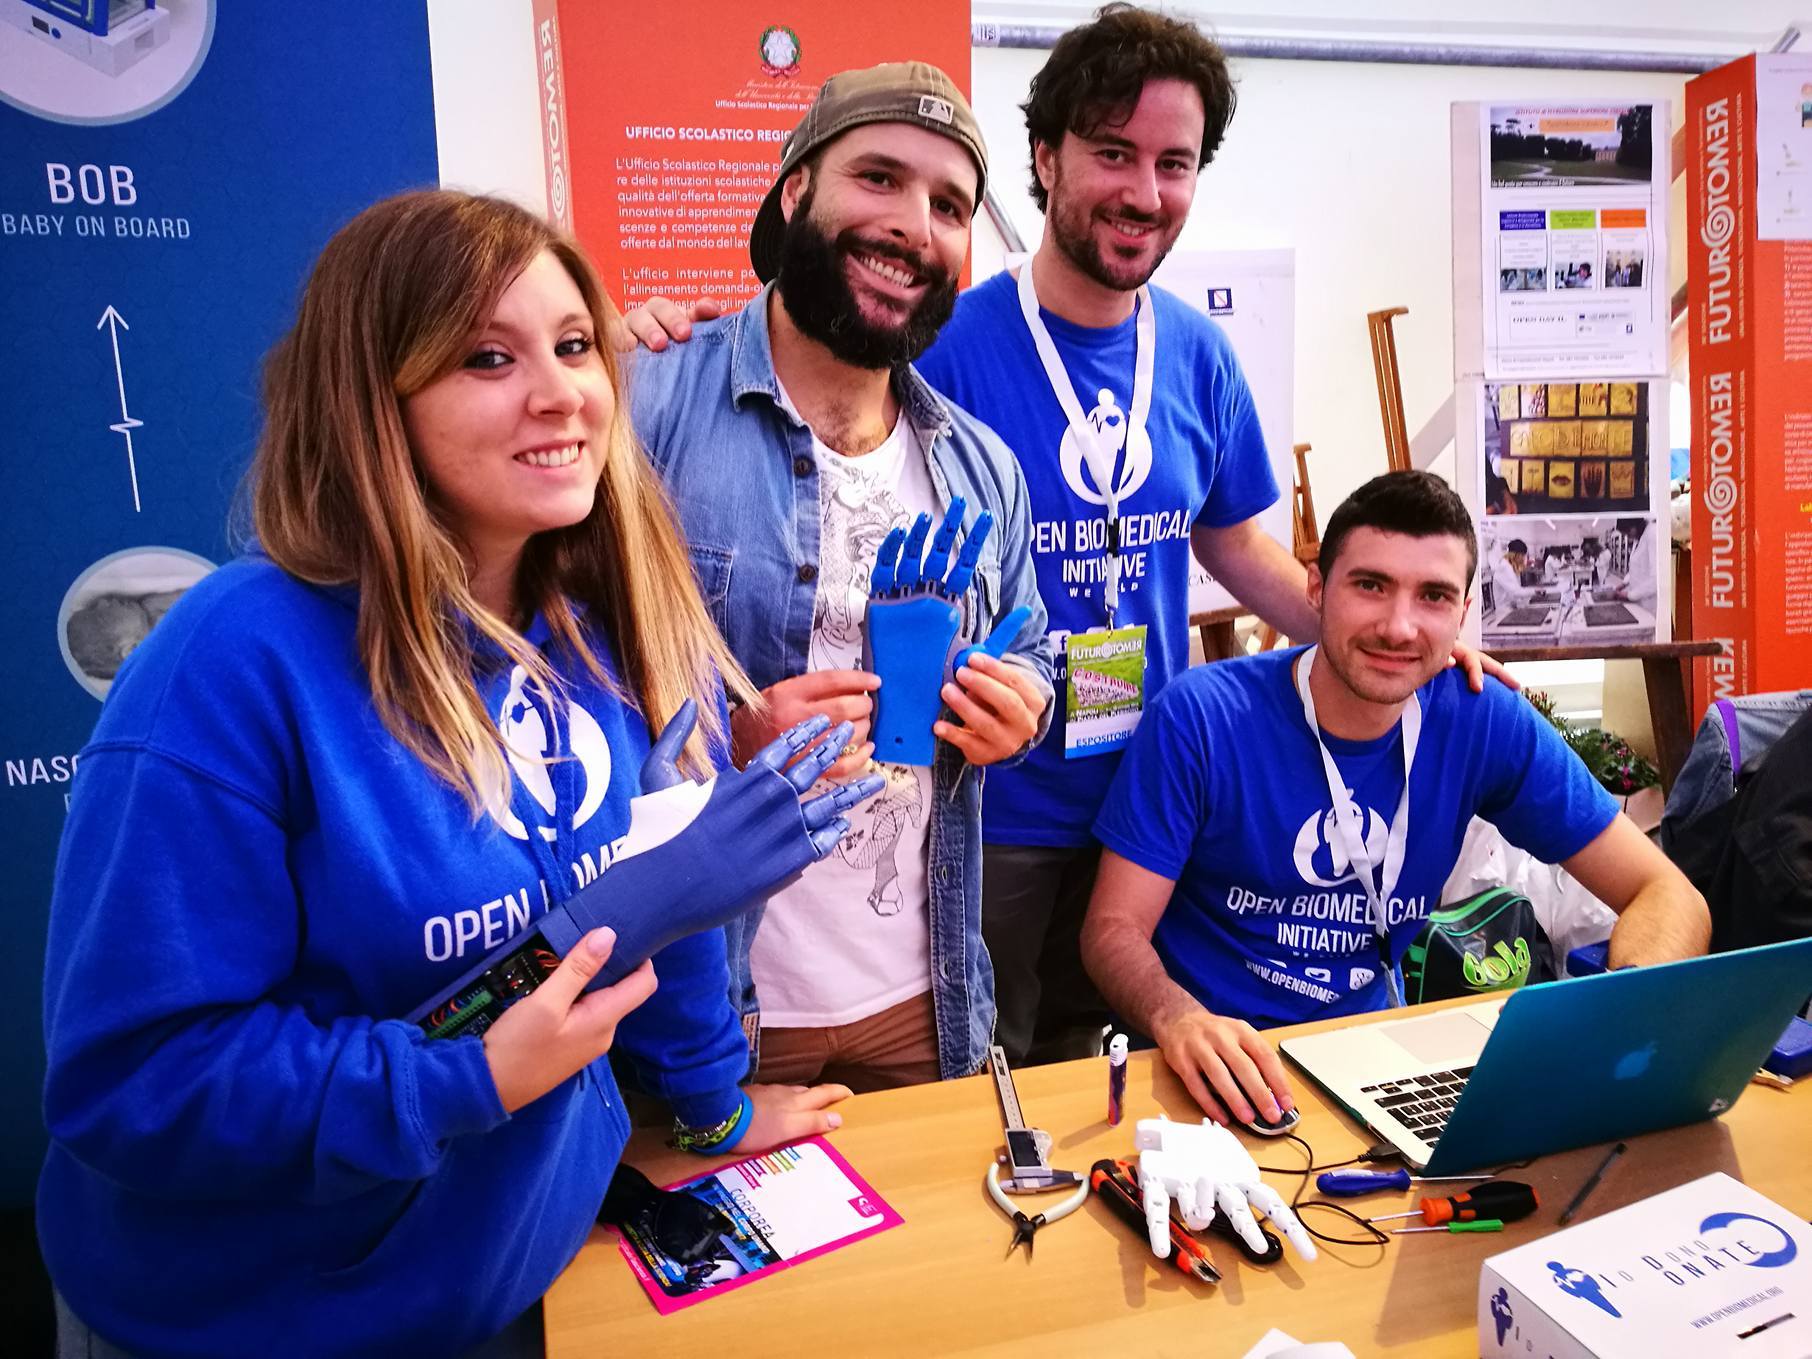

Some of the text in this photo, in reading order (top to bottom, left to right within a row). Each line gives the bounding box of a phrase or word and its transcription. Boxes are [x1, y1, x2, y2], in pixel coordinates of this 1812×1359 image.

[715, 100, 736, 108] Ufficio
[737, 100, 767, 109] Scolastico
[768, 101, 798, 112] Regionale
[625, 126, 675, 140] UFFICIO
[678, 127, 754, 141] SCOLASTICO
[616, 157, 660, 171] L'Ufficio
[662, 158, 715, 171] Scolastico
[718, 159, 770, 174] Regionale
[46, 162, 137, 206] BOB
[616, 174, 771, 187] re delle istituzioni scolastiche
[617, 189, 654, 204] qualità
[657, 189, 715, 202] dell'offerta
[618, 206, 674, 219] innovative
[676, 206, 686, 218] di
[1, 213, 190, 239] BABY ON BOARD
[619, 223, 657, 234] scenze
[660, 223, 668, 233] e
[671, 222, 737, 236] competenze
[620, 236, 657, 249] offerte
[658, 236, 675, 249] dal
[676, 236, 715, 249] mondo
[716, 236, 735, 249] del
[622, 267, 669, 280] L'ufficio
[676, 267, 734, 280] interviene
[623, 282, 698, 295] l'allineamento
[1062, 552, 1147, 583] INITIAIVE
[1076, 729, 1134, 748] ESPOSITORE
[1226, 886, 1430, 926] OPEN BIOMEDCAL
[424, 888, 531, 962] OPEN
[1277, 922, 1373, 953] INITIATIVE
[730, 1188, 775, 1239] CORPOREA
